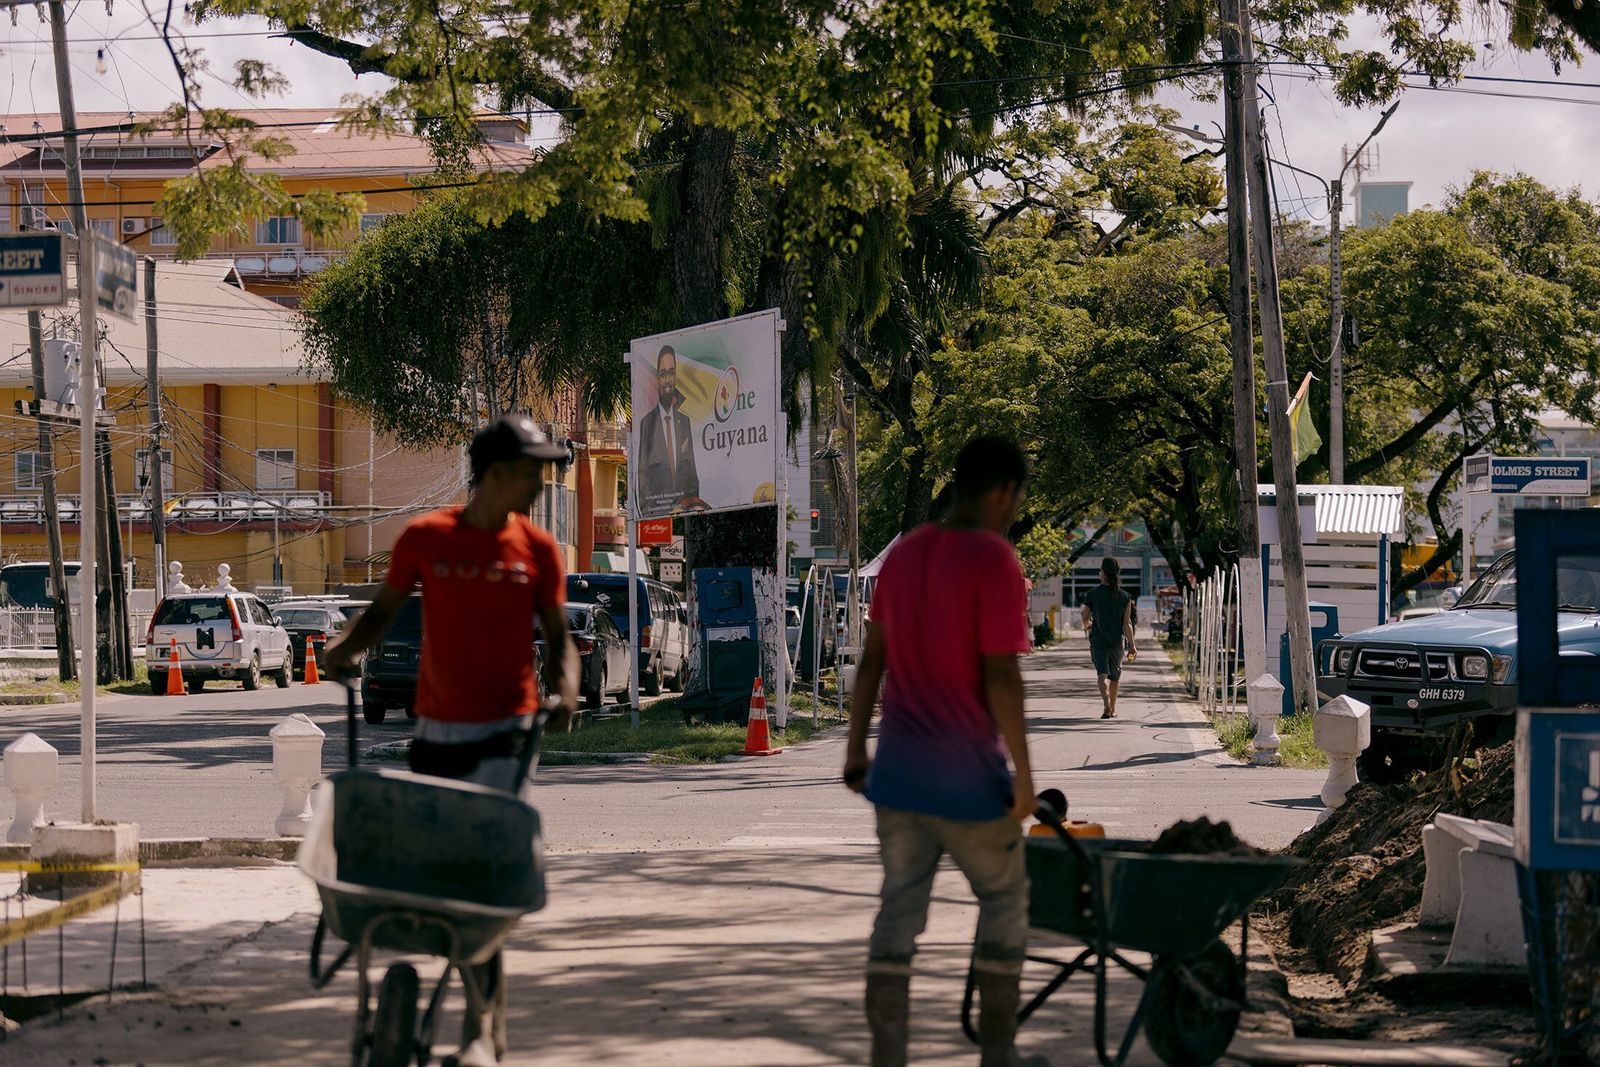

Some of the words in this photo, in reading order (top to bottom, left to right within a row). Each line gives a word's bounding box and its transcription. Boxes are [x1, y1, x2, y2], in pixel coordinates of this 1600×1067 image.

[0, 249, 44, 270] EET
[14, 285, 58, 295] SINGER
[713, 365, 756, 424] One
[701, 422, 768, 458] Guyana
[1491, 466, 1531, 476] OLMES
[1534, 466, 1579, 476] STREET
[1419, 688, 1441, 699] GHH
[1442, 689, 1465, 700] 6379
